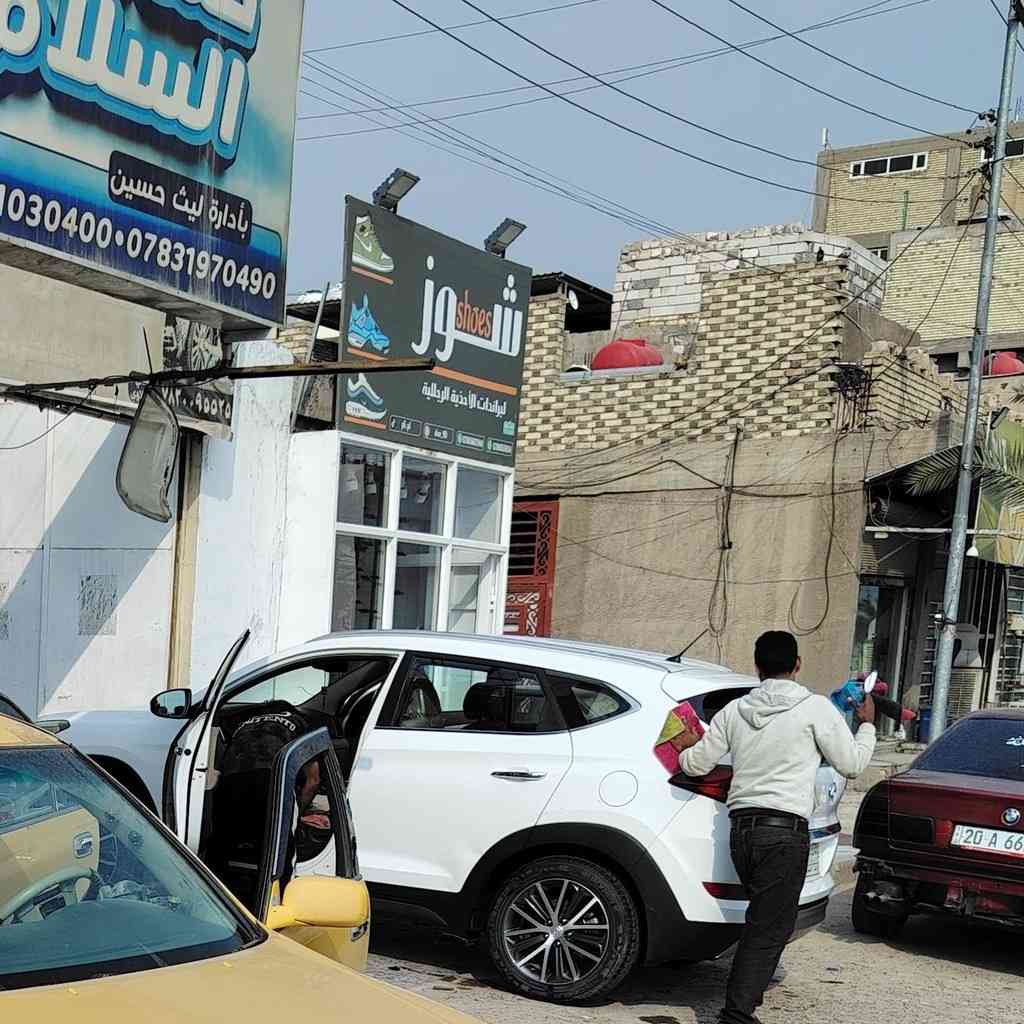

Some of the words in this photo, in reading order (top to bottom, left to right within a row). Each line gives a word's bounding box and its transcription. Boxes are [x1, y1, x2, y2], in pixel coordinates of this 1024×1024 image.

[109, 168, 166, 208] حسين
[172, 185, 205, 222] ليث
[126, 227, 276, 300] 07831970490
[411, 255, 523, 362] شوز
[964, 829, 982, 846] 20
[988, 832, 998, 848] A
